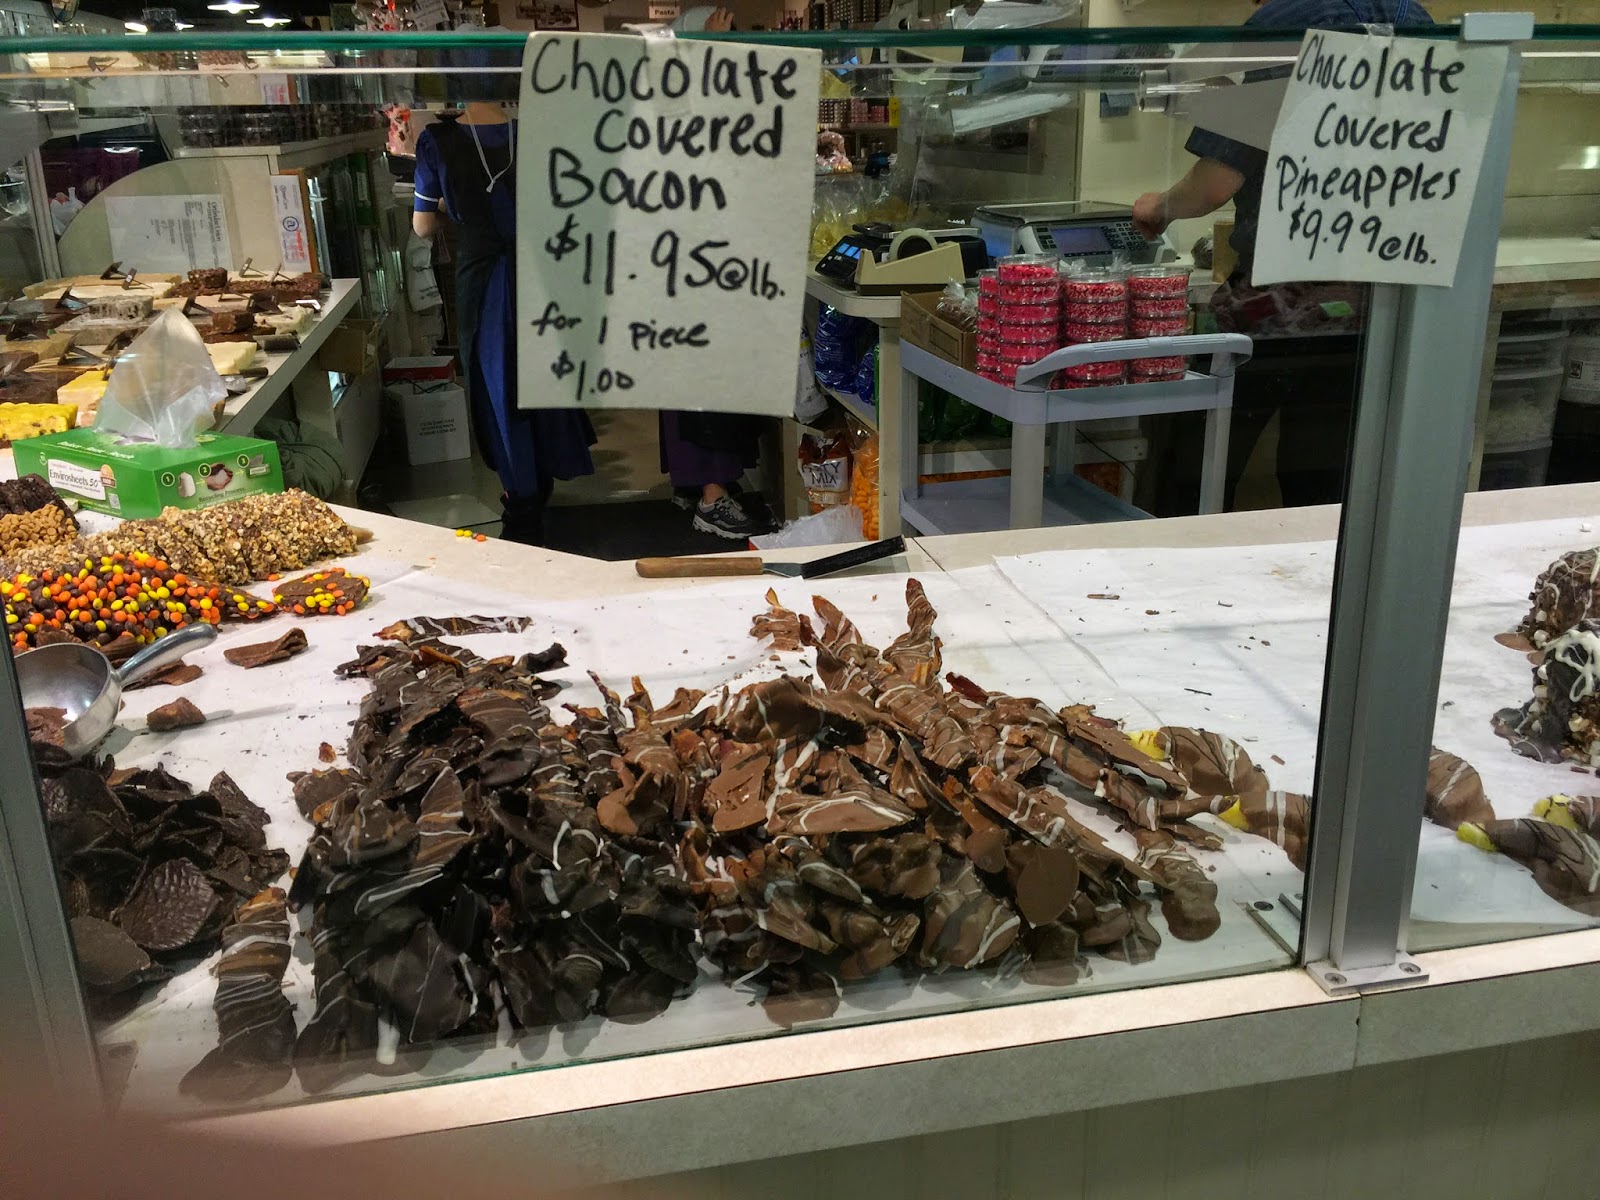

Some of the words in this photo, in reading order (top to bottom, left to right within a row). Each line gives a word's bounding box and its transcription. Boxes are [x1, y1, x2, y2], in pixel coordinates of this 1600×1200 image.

[531, 38, 798, 104] Chocolate
[1296, 33, 1466, 98] Chocolate
[594, 104, 783, 158] Covered
[1314, 102, 1453, 153] Covered
[549, 147, 727, 213] Bacon
[1276, 154, 1461, 212] Pineapples
[531, 301, 582, 336] for
[598, 316, 608, 345] 1
[551, 350, 635, 401] $1.00
[49, 468, 89, 486] Envirosheets
[89, 478, 99, 488] 50
[811, 472, 838, 485] MIX
